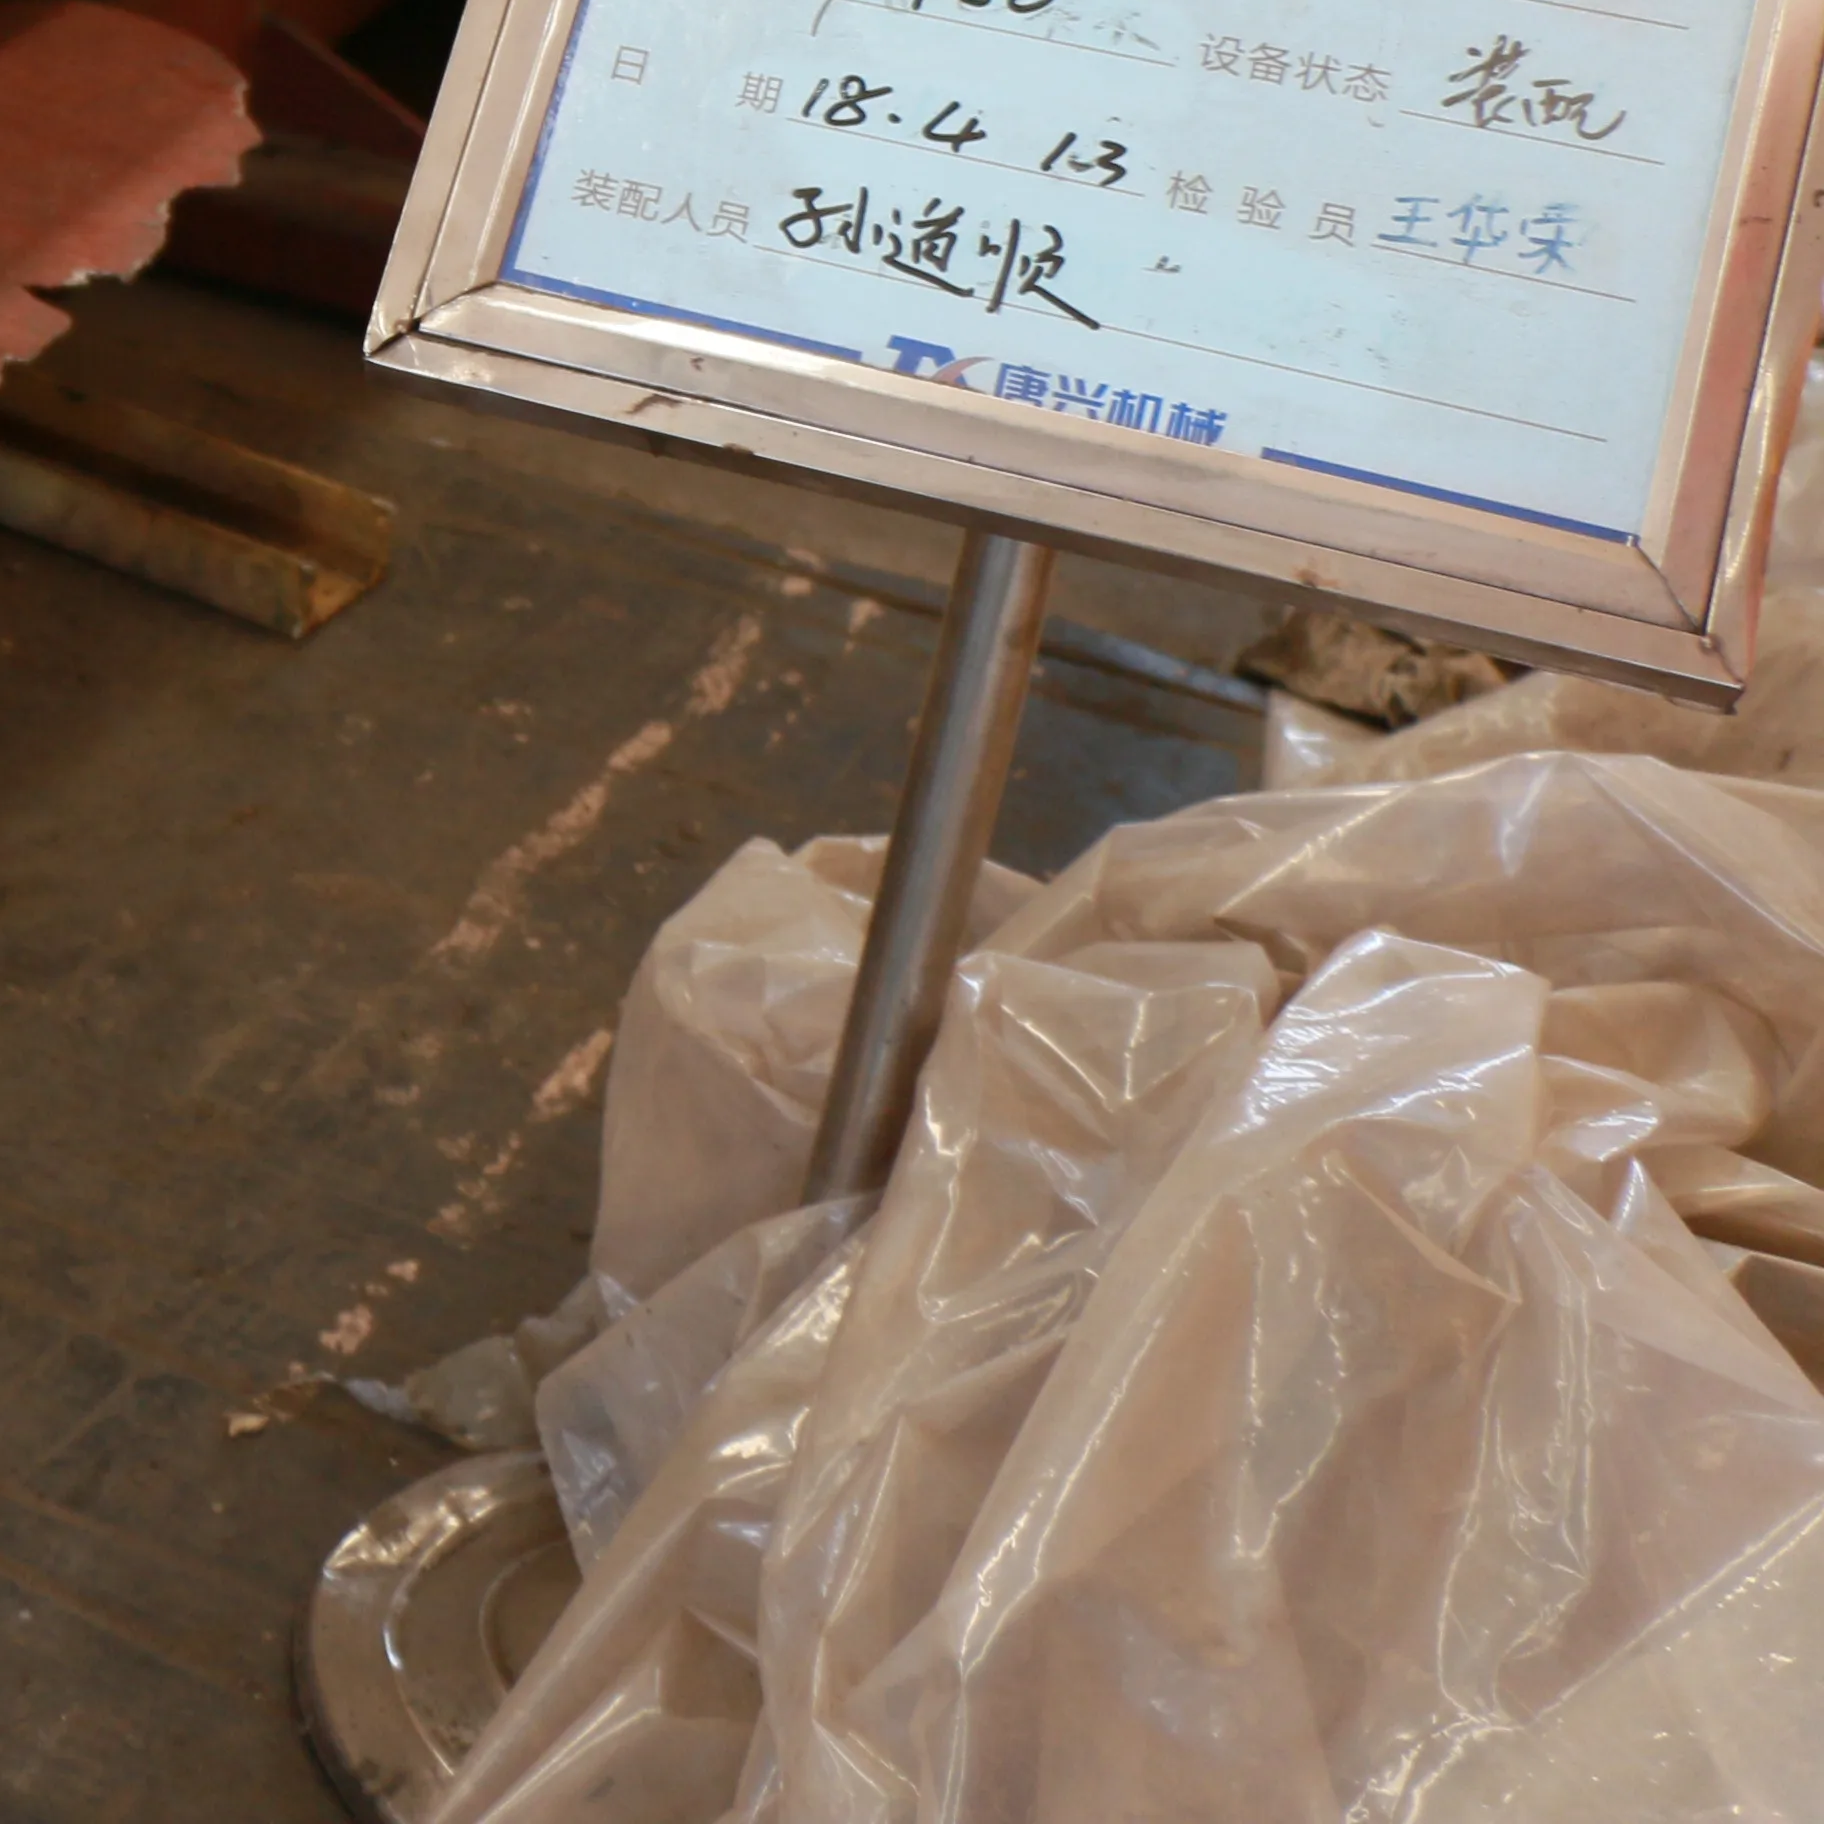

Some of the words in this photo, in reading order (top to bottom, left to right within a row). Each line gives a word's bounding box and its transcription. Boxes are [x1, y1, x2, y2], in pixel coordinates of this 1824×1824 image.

[1198, 32, 1393, 103] 设备状态
[571, 167, 751, 245] 装配人员
[1166, 170, 1356, 248] 检验员
[992, 362, 1228, 447] 唐兴机械
